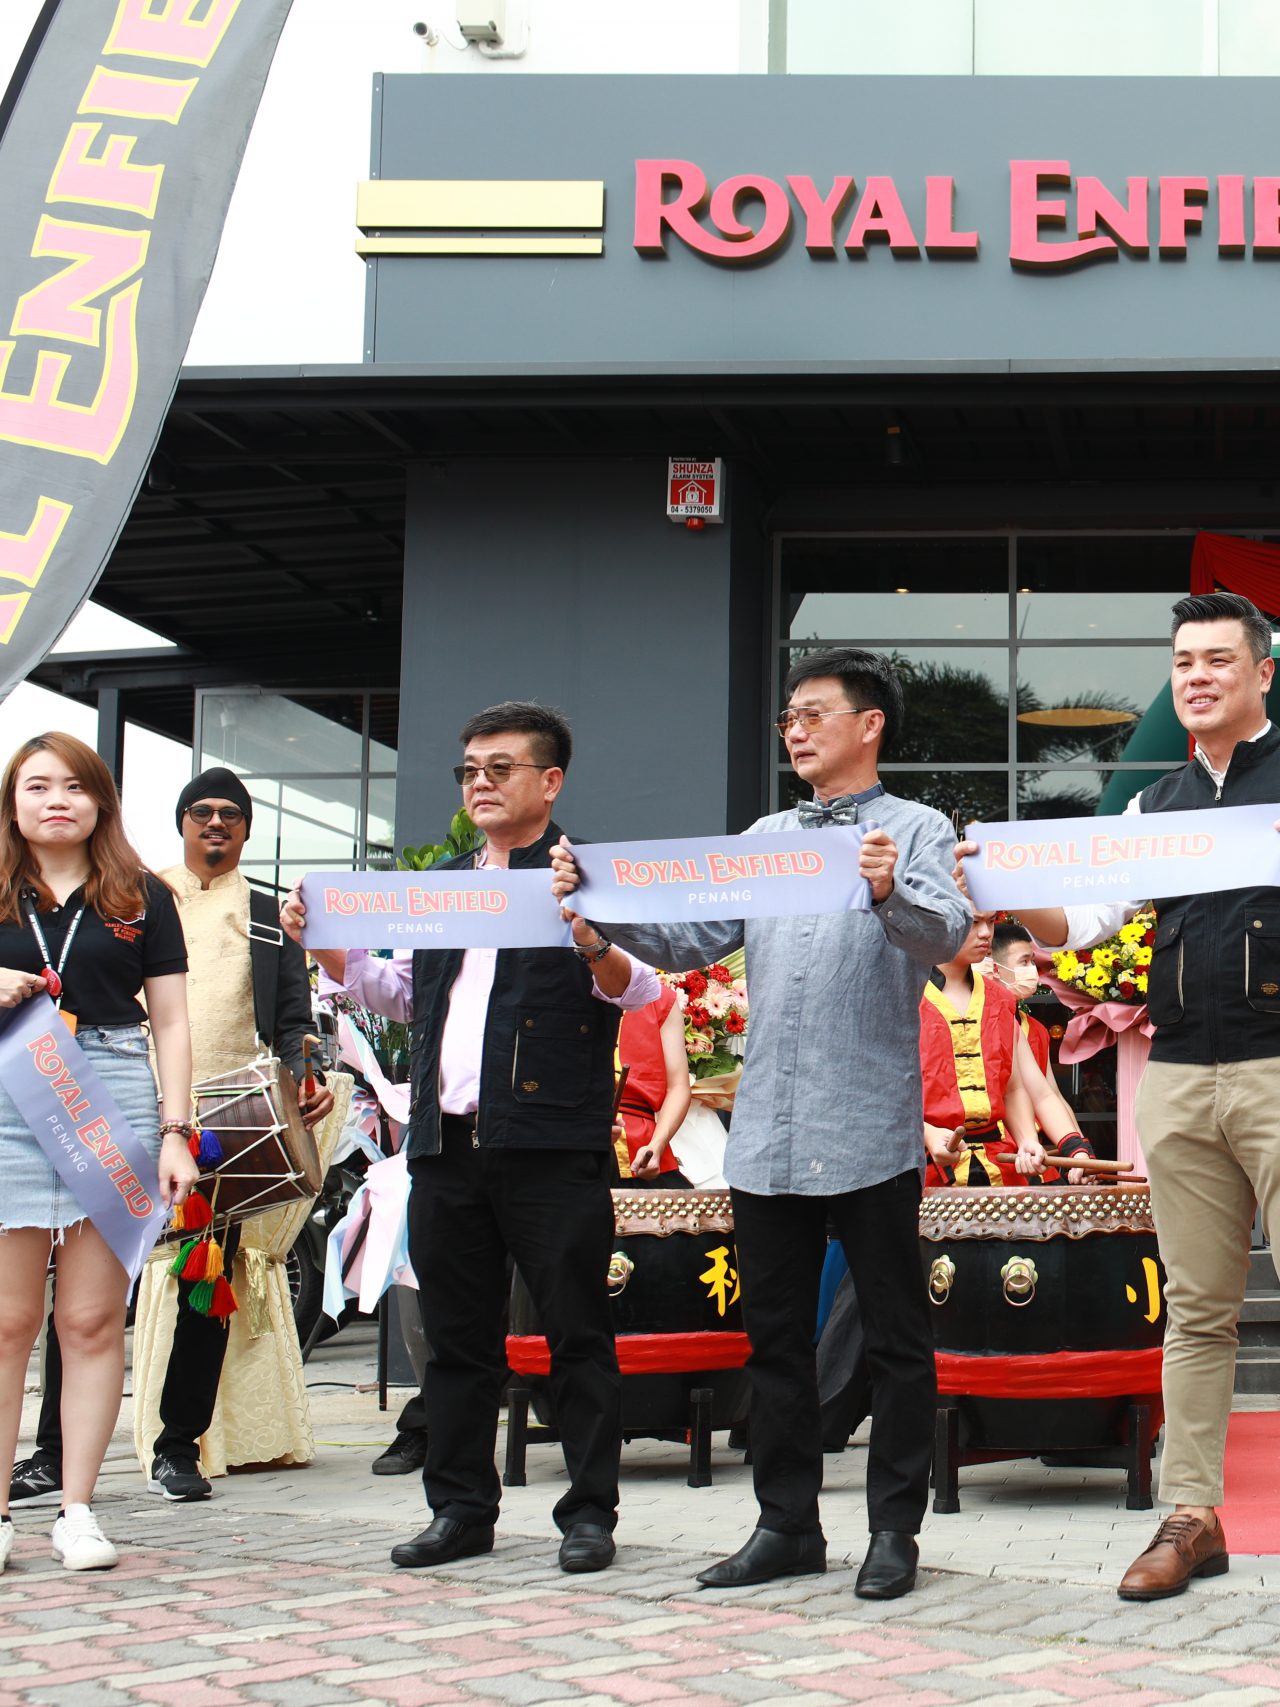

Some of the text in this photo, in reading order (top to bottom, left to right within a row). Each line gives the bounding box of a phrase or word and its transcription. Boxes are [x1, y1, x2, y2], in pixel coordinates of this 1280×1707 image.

[633, 158, 981, 264] ROYAL
[672, 463, 713, 474] SHUNZA
[611, 850, 825, 888] ROYAL ENFIELD
[984, 832, 1216, 872] ROYAL ENFIELD
[688, 889, 752, 904] PENANG
[1062, 872, 1132, 889] PENANG
[324, 887, 508, 917] ROYAL ENFIELD
[387, 923, 444, 934] PENANG
[26, 1032, 155, 1219] ROYAL ENFIELD
[46, 1114, 89, 1174] PENANG
